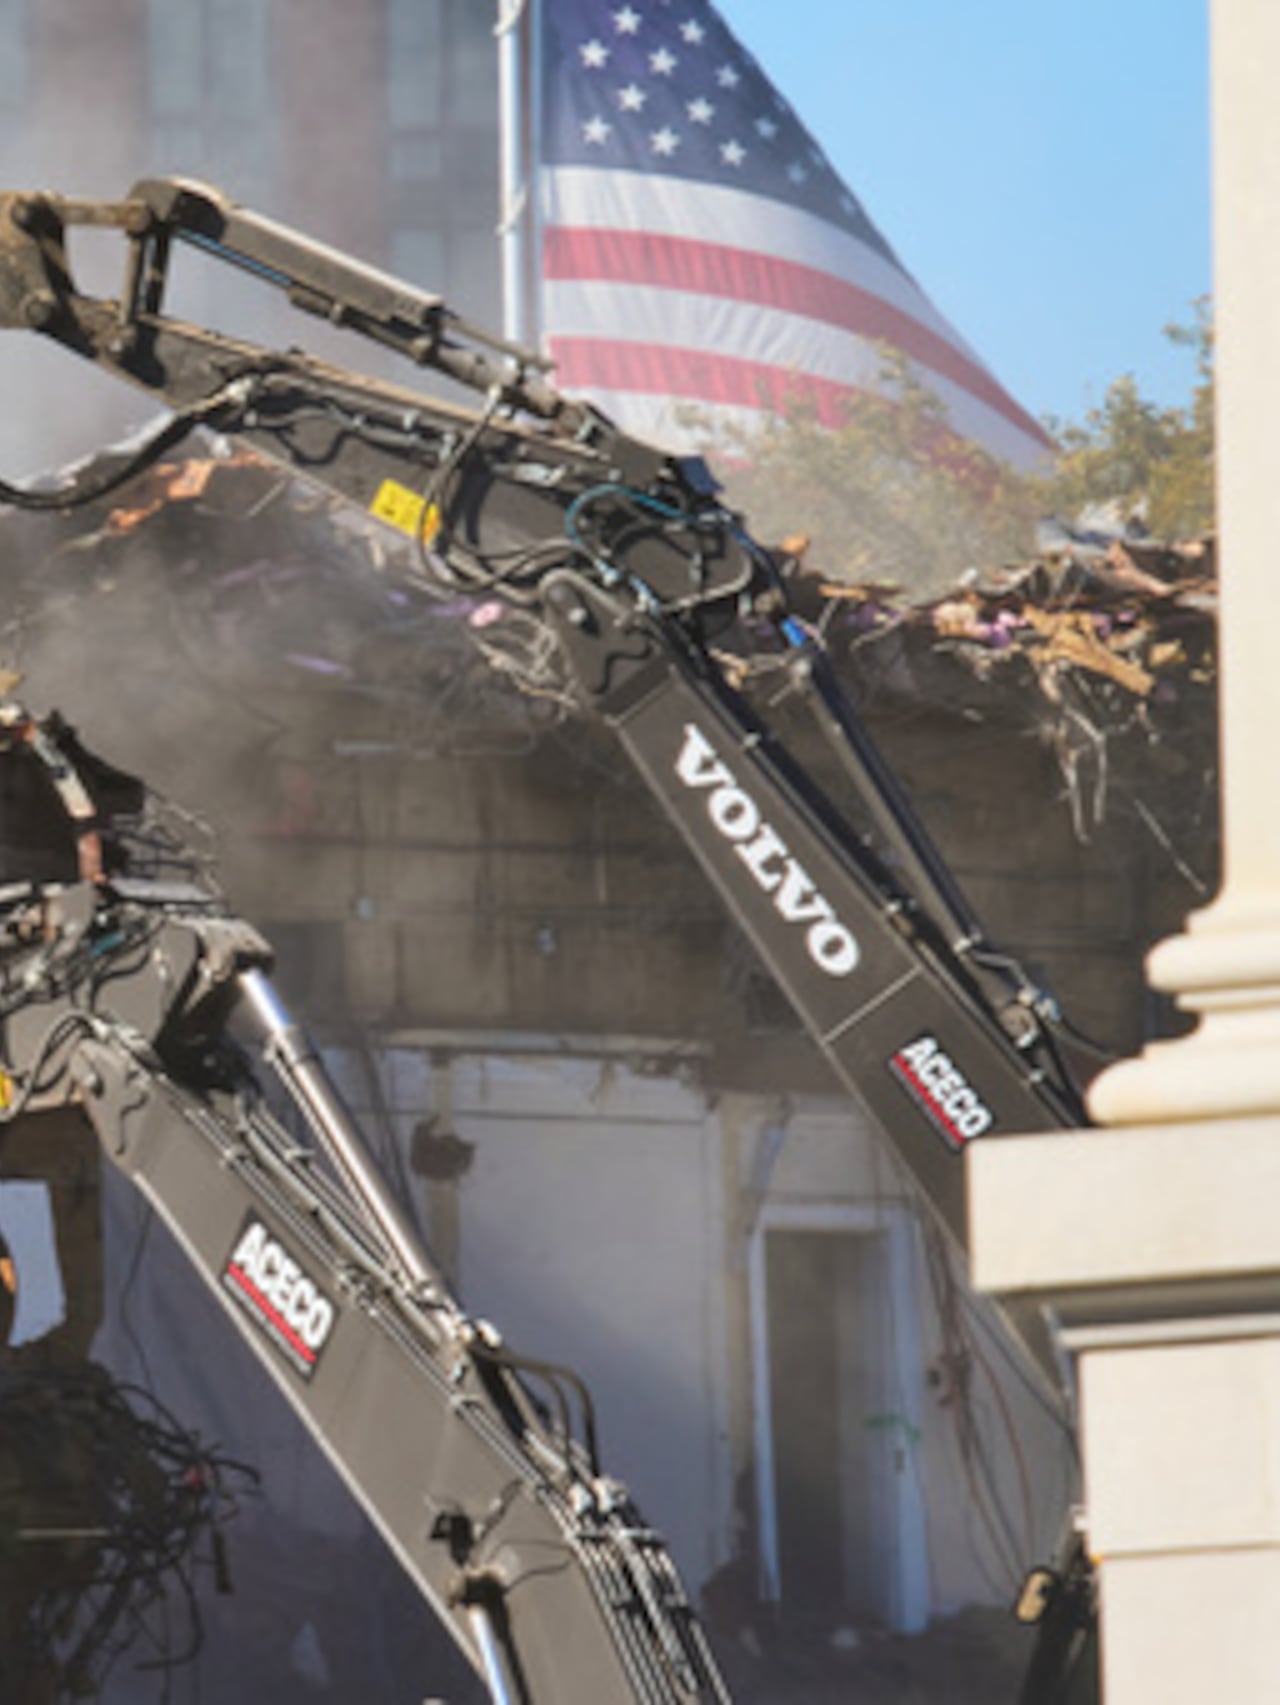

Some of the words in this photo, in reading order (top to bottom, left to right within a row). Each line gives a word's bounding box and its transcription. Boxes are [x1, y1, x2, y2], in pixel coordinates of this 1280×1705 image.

[675, 723, 859, 977] VOLVO
[900, 1037, 992, 1138] ACECO
[232, 1222, 334, 1350] ACECO
